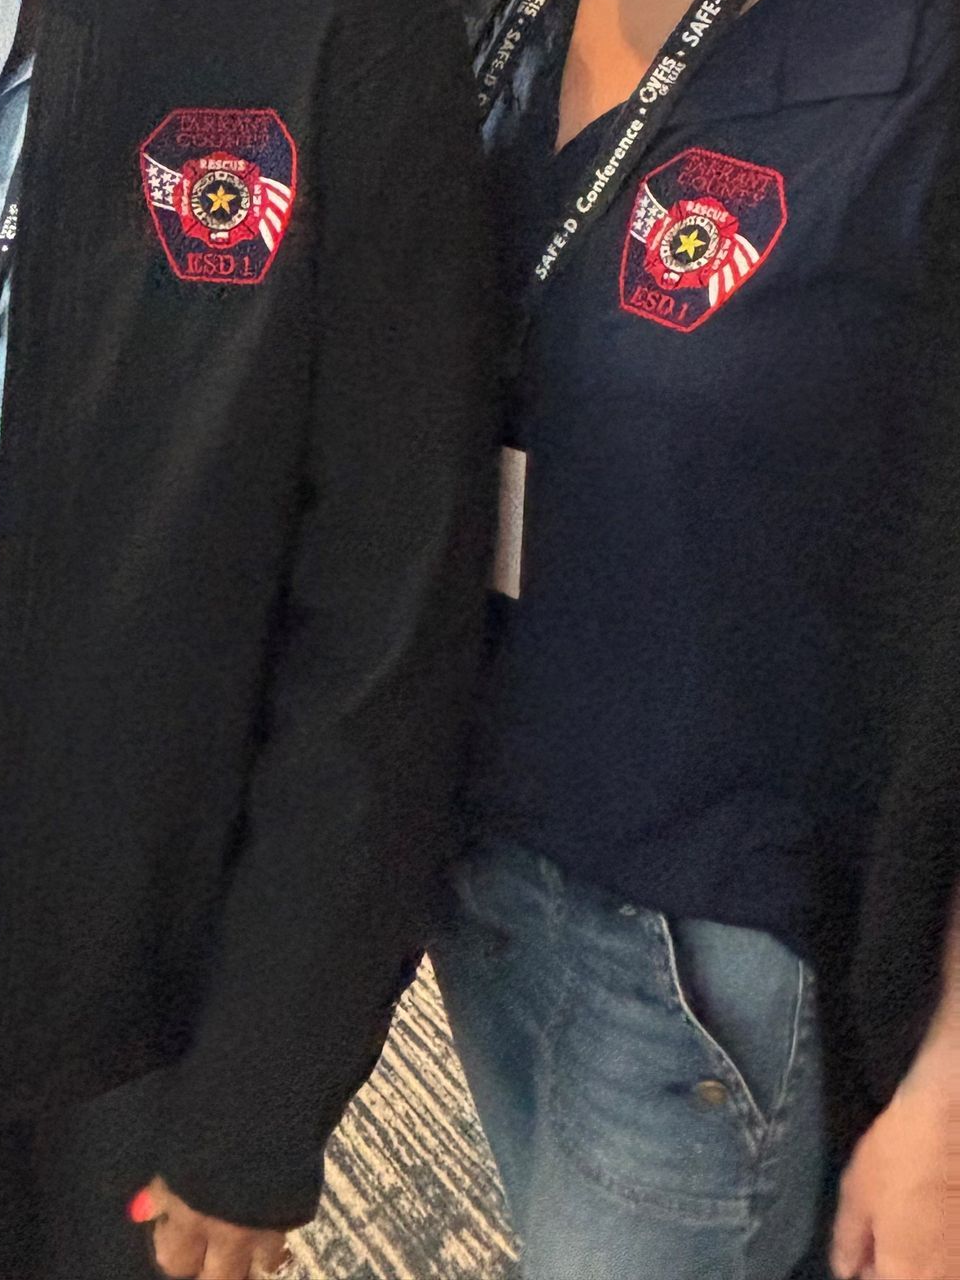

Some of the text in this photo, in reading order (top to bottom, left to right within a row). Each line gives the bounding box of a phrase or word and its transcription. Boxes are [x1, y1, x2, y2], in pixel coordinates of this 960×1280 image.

[535, 218, 577, 280] SAFE-D
[576, 119, 644, 214] Conference
[187, 252, 235, 275] ESD
[631, 286, 675, 316] ESD
